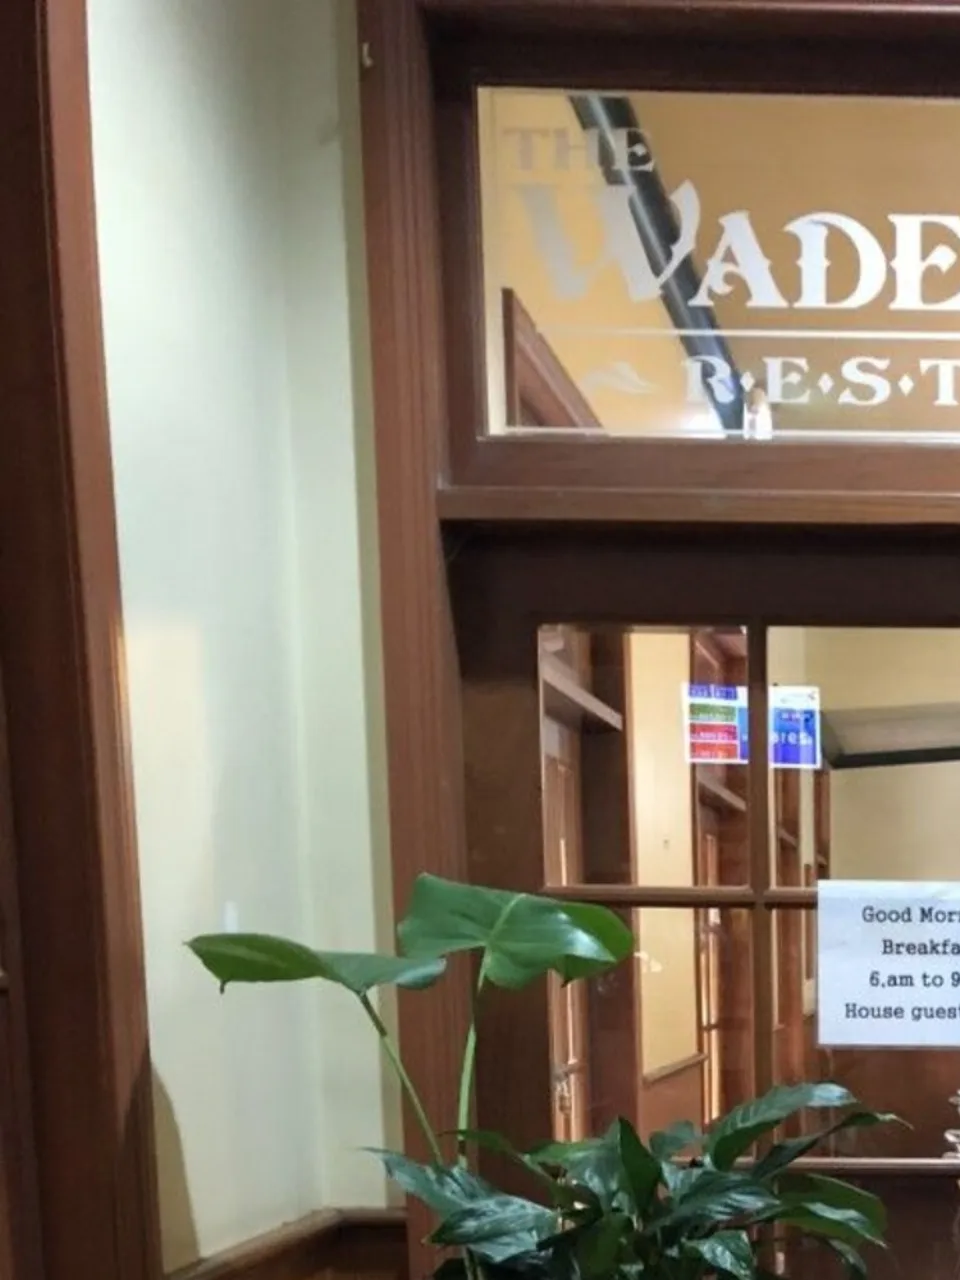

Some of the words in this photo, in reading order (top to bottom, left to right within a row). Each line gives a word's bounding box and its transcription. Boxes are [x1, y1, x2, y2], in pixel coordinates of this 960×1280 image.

[502, 126, 655, 171] THE
[862, 905, 912, 923] Good
[869, 971, 914, 988] 6.am
[922, 973, 944, 987] to
[845, 1003, 905, 1019] House
